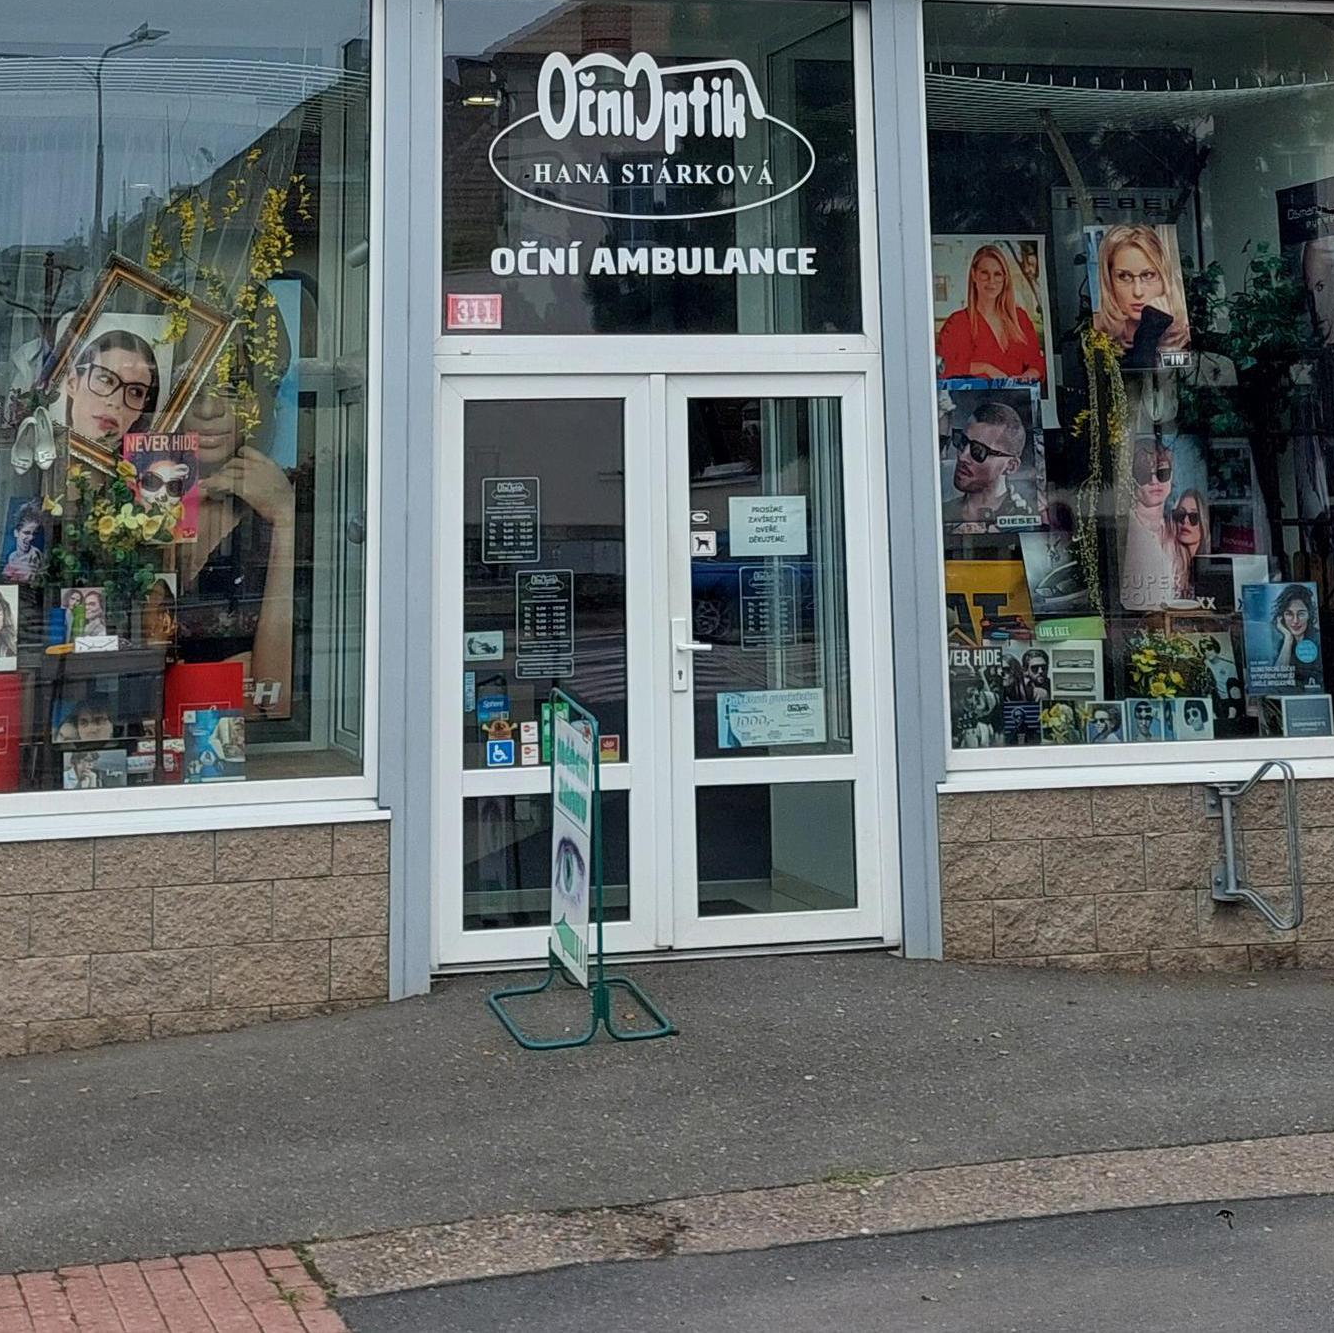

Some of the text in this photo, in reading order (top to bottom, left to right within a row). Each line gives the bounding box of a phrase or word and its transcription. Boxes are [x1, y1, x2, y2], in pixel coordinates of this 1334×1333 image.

[533, 158, 774, 185] HANA STÁRKOVÁ
[490, 241, 819, 276] OČNÍ AMBULANCE
[457, 300, 493, 324] 311
[126, 434, 199, 452] NEVER HIDE
[998, 517, 1040, 525] DIESEL
[973, 649, 1002, 666] HIDE
